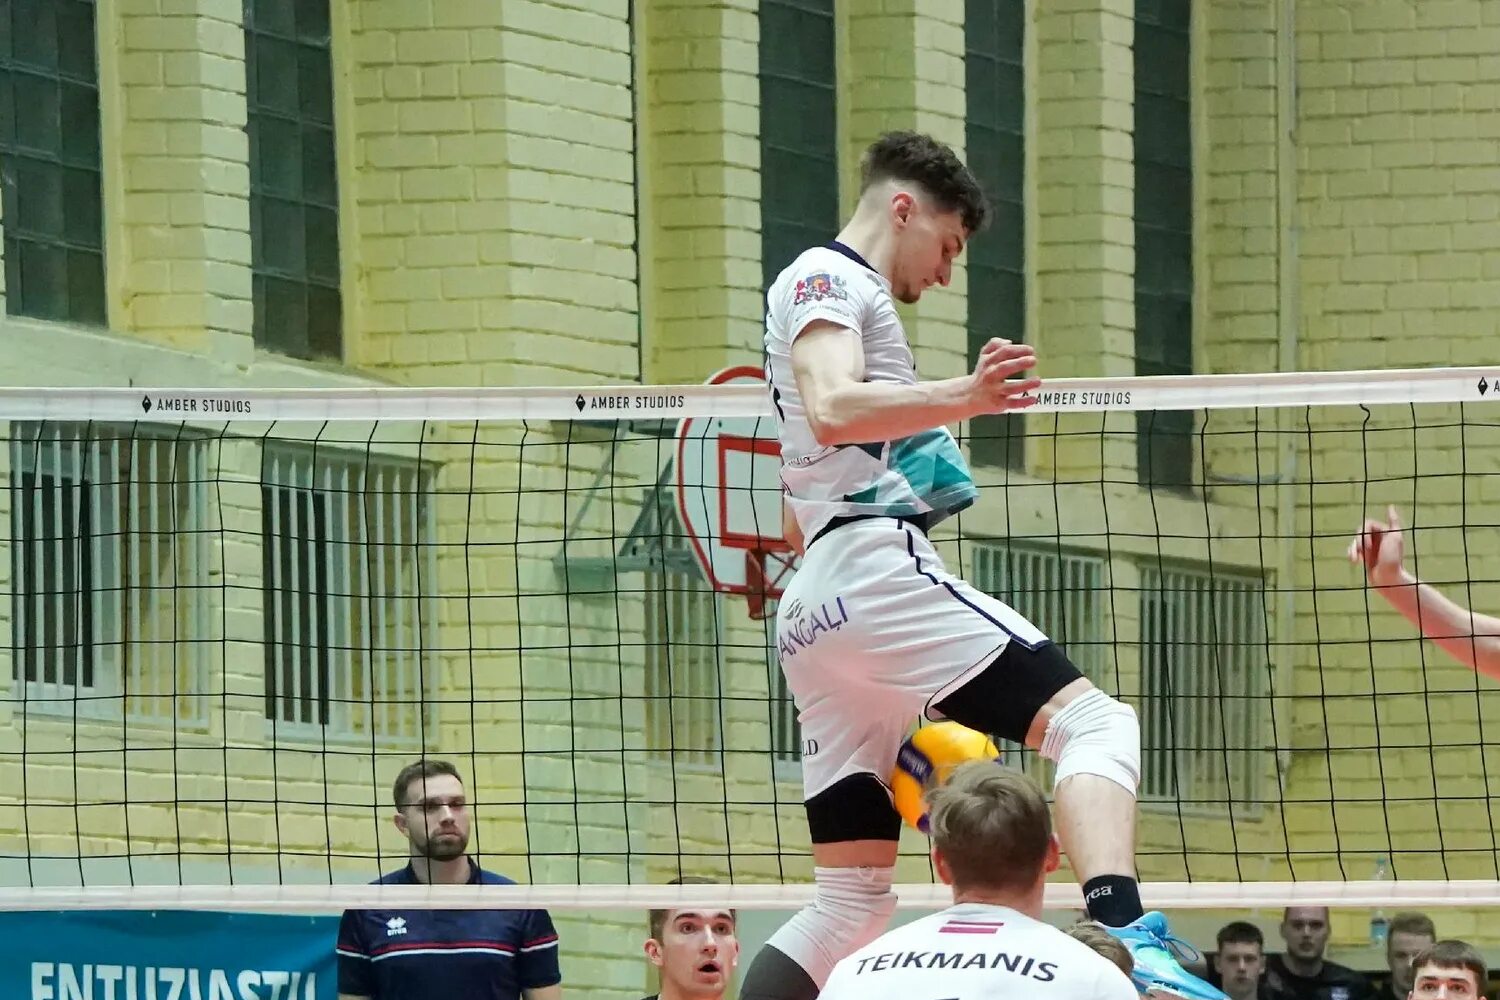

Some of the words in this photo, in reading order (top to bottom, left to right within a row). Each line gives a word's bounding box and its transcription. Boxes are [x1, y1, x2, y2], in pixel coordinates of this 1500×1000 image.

[591, 396, 630, 408] AMBER
[635, 395, 685, 408] STUDIOS
[1035, 392, 1076, 405] AMBER
[1081, 391, 1131, 405] STUDIOS
[156, 399, 197, 412] AMBER
[202, 399, 251, 413] STUDIOS
[778, 597, 849, 662] ANGAĻI
[856, 951, 1059, 982] TEIKMANIS
